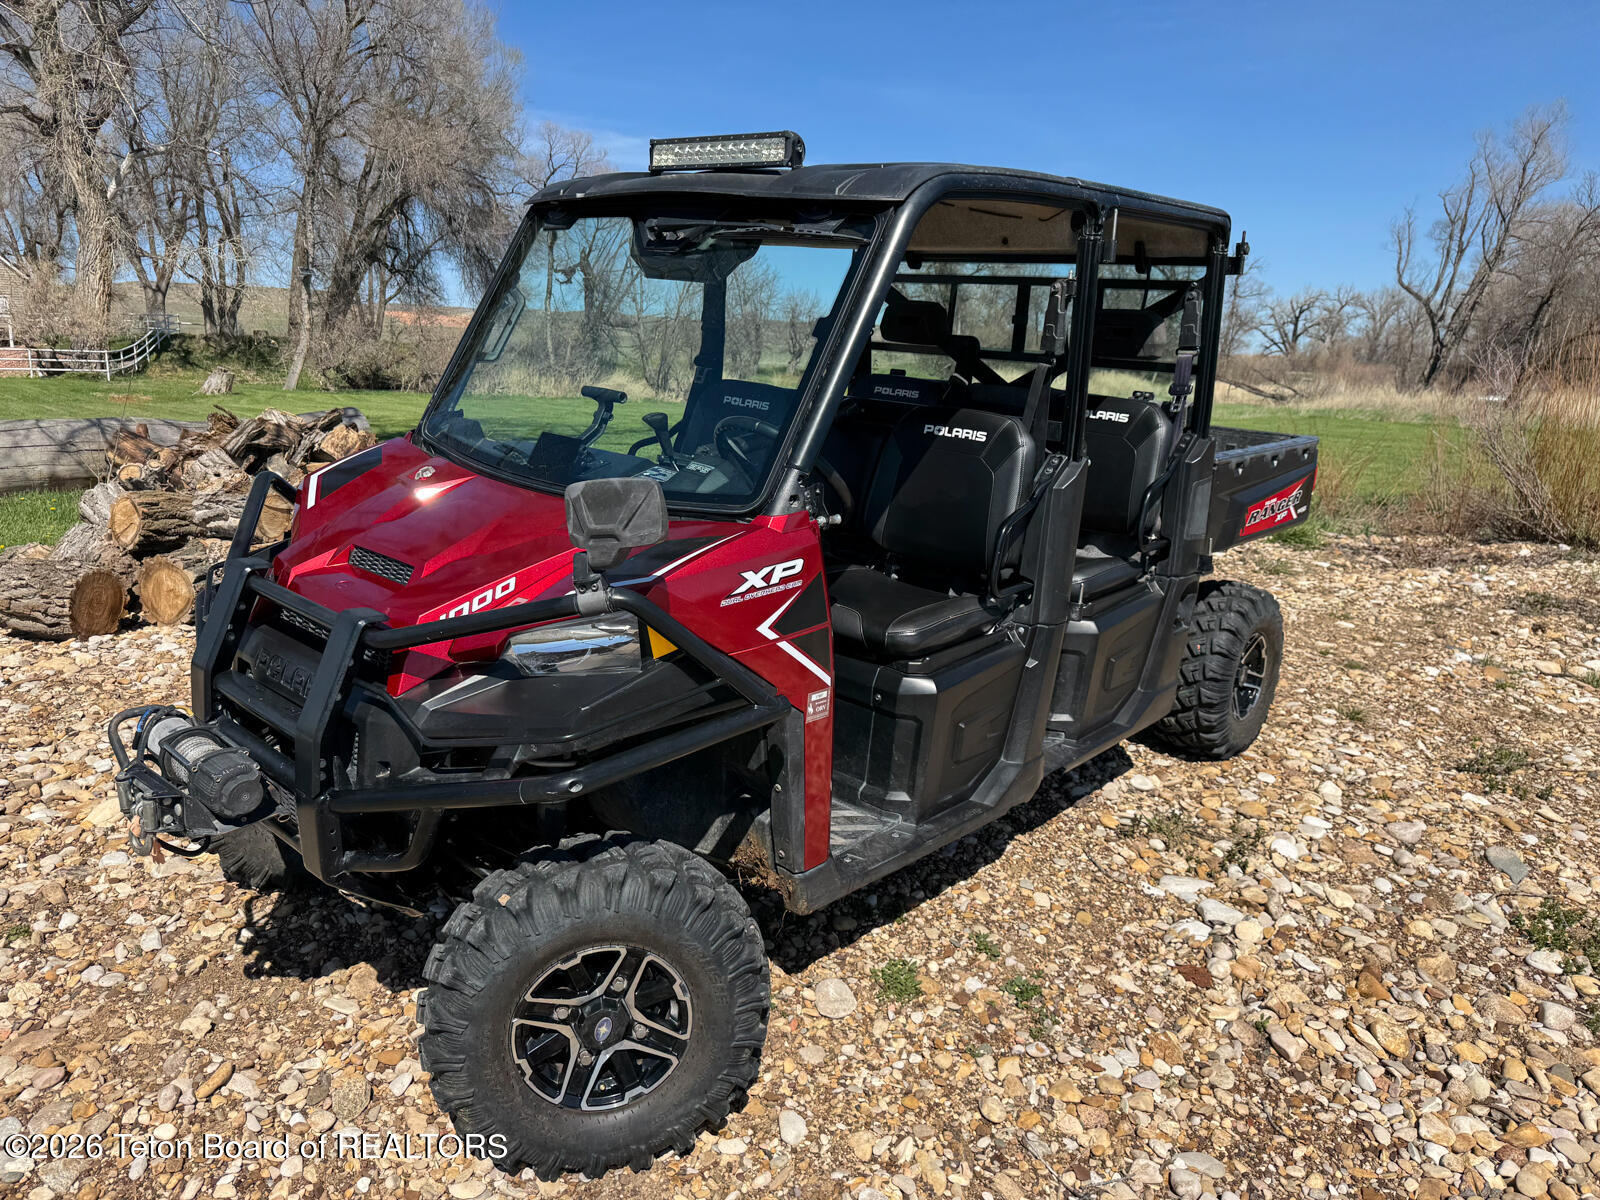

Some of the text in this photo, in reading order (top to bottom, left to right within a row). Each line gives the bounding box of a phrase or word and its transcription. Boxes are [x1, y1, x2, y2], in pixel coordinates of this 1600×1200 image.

[722, 395, 770, 411] POLARIS
[874, 386, 920, 399] POLARIS
[923, 424, 988, 442] POLARIS
[1245, 489, 1303, 527] RANGER
[726, 558, 804, 596] XP
[253, 646, 312, 698] POLA
